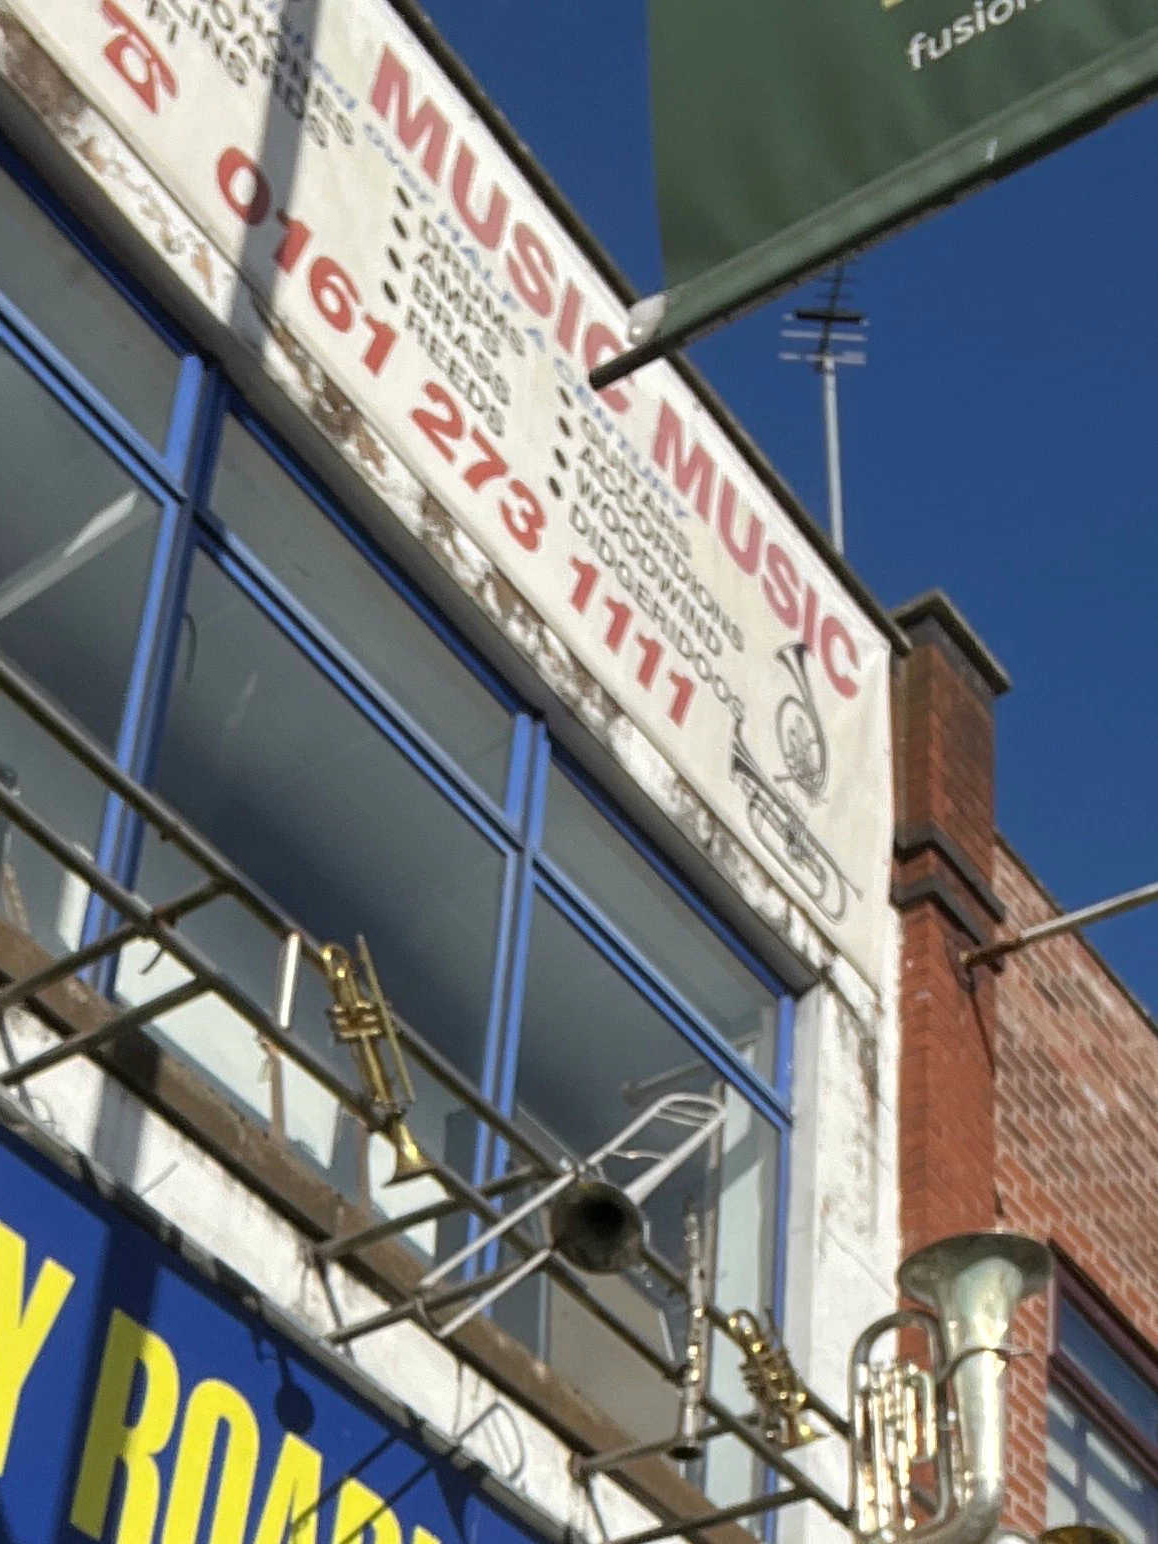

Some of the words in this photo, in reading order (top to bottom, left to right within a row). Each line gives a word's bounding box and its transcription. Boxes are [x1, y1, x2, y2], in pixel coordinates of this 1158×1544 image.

[906, 0, 1042, 70] fusio
[411, 272, 512, 407] BRASS
[415, 252, 501, 358] AMPS
[419, 214, 527, 357] DRUMS
[438, 211, 520, 313] HALF
[524, 327, 546, 354] A
[553, 357, 690, 519] CENTURY
[215, 146, 399, 377] 0161
[410, 381, 548, 554] 273
[569, 555, 696, 729] 1111
[369, 41, 635, 415] MUSIC
[652, 400, 860, 700] MUSIC
[405, 304, 506, 438] REEDS
[574, 467, 722, 657] WOODWIND
[579, 446, 745, 653] ACCORDIONS
[580, 414, 692, 560] GUITARS
[569, 503, 745, 724] DIDGERIDOOS
